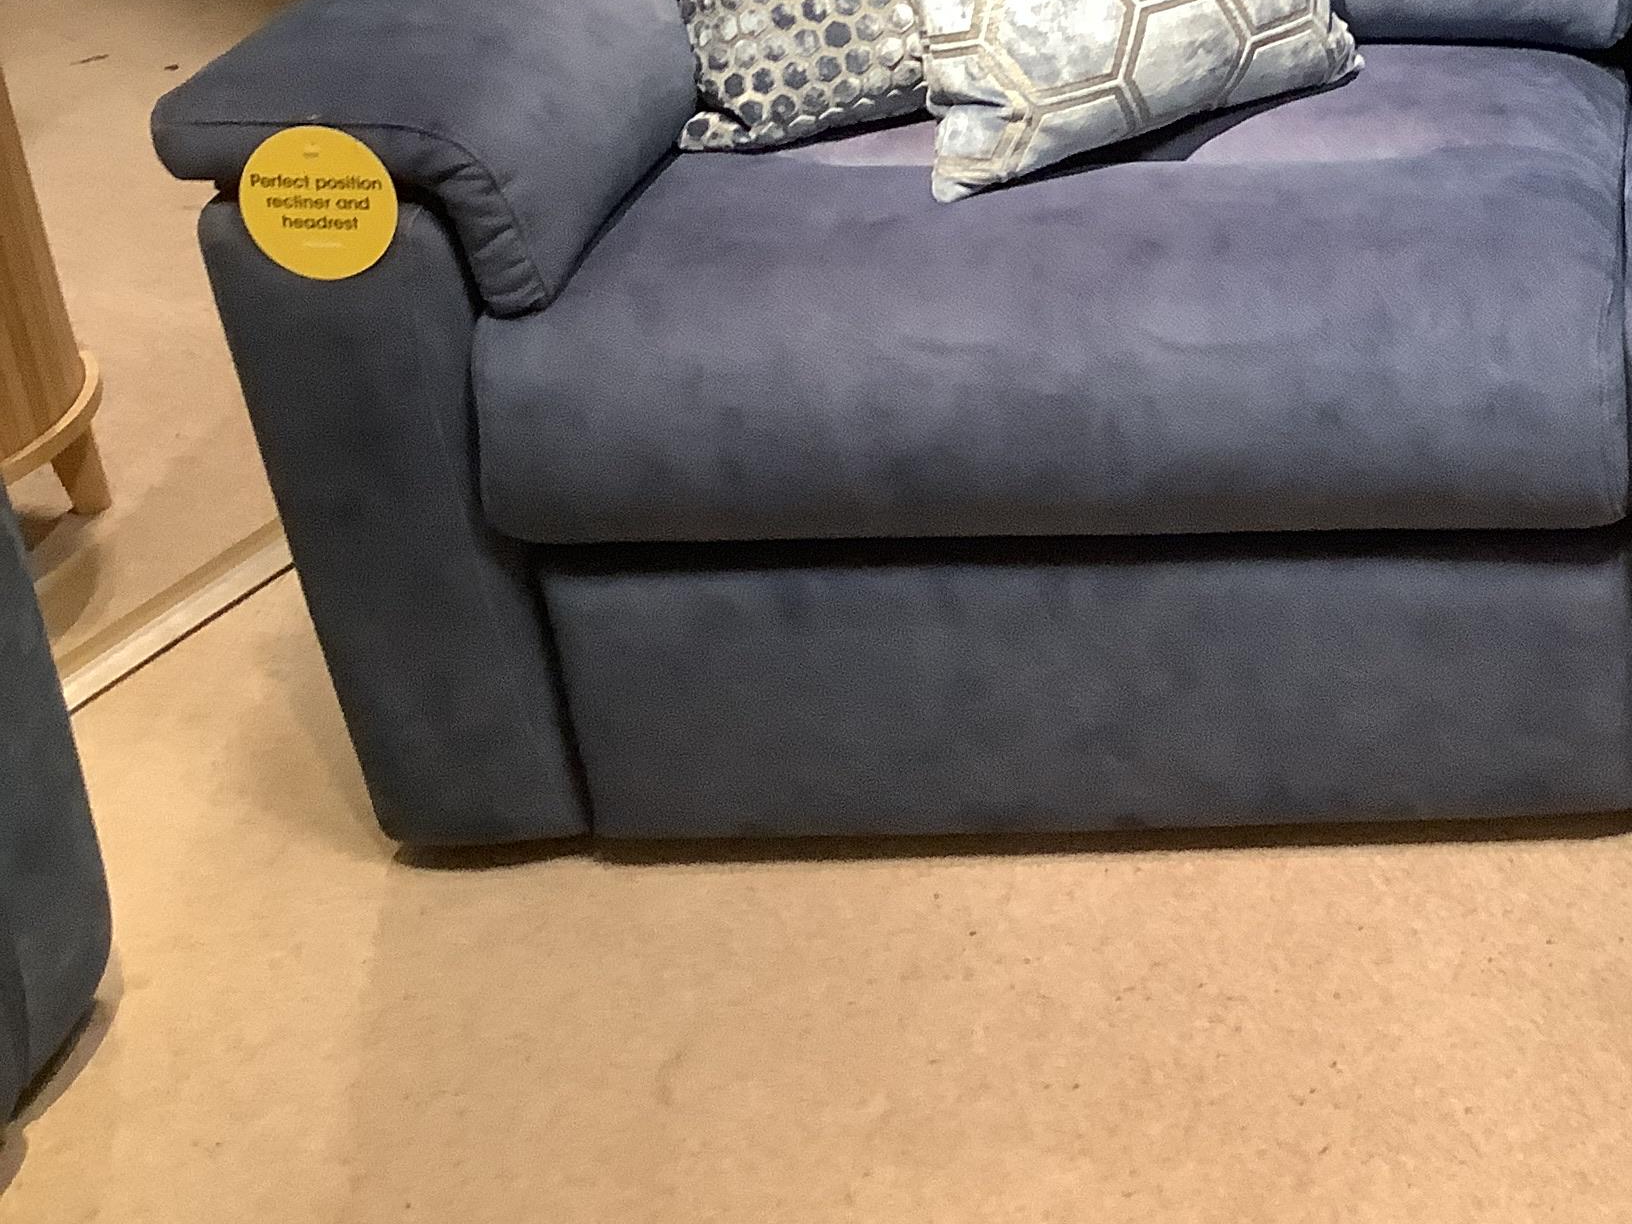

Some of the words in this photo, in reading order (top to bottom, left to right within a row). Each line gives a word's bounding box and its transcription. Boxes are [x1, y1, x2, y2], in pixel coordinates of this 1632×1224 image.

[250, 173, 310, 189] Perfect
[315, 174, 382, 191] position
[266, 195, 330, 209] recliner
[335, 196, 370, 210] and
[281, 214, 359, 230] headrest
